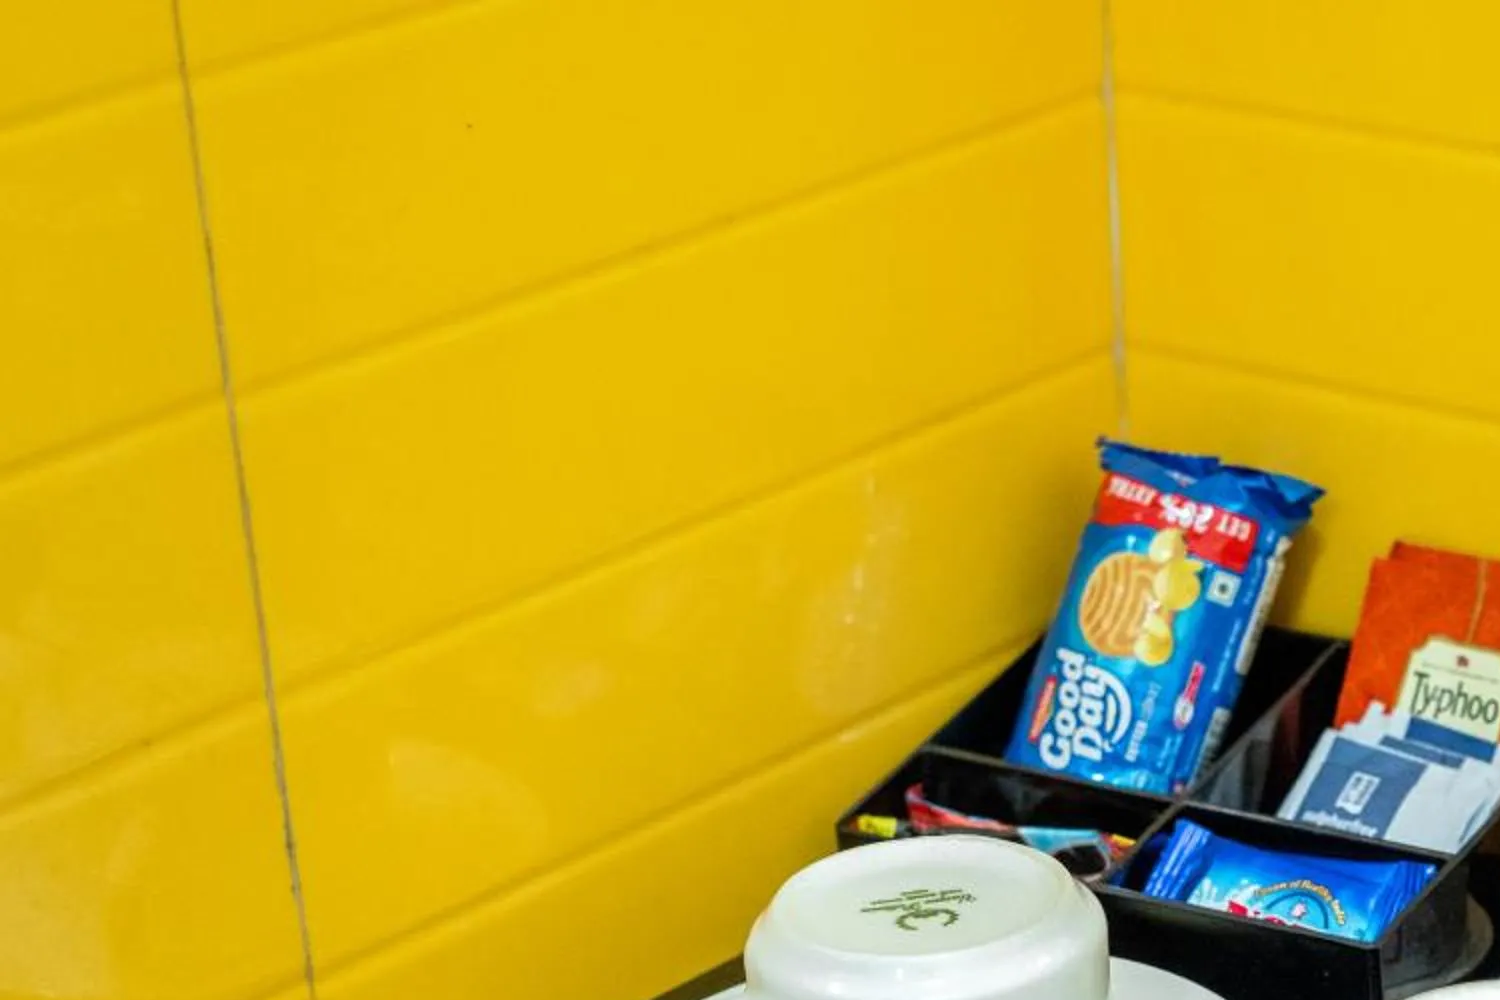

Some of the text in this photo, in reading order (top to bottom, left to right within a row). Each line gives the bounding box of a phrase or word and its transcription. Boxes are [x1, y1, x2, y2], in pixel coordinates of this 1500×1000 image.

[1039, 648, 1085, 769] Good
[1072, 664, 1132, 761] Day
[1410, 671, 1499, 725] Typhoo
